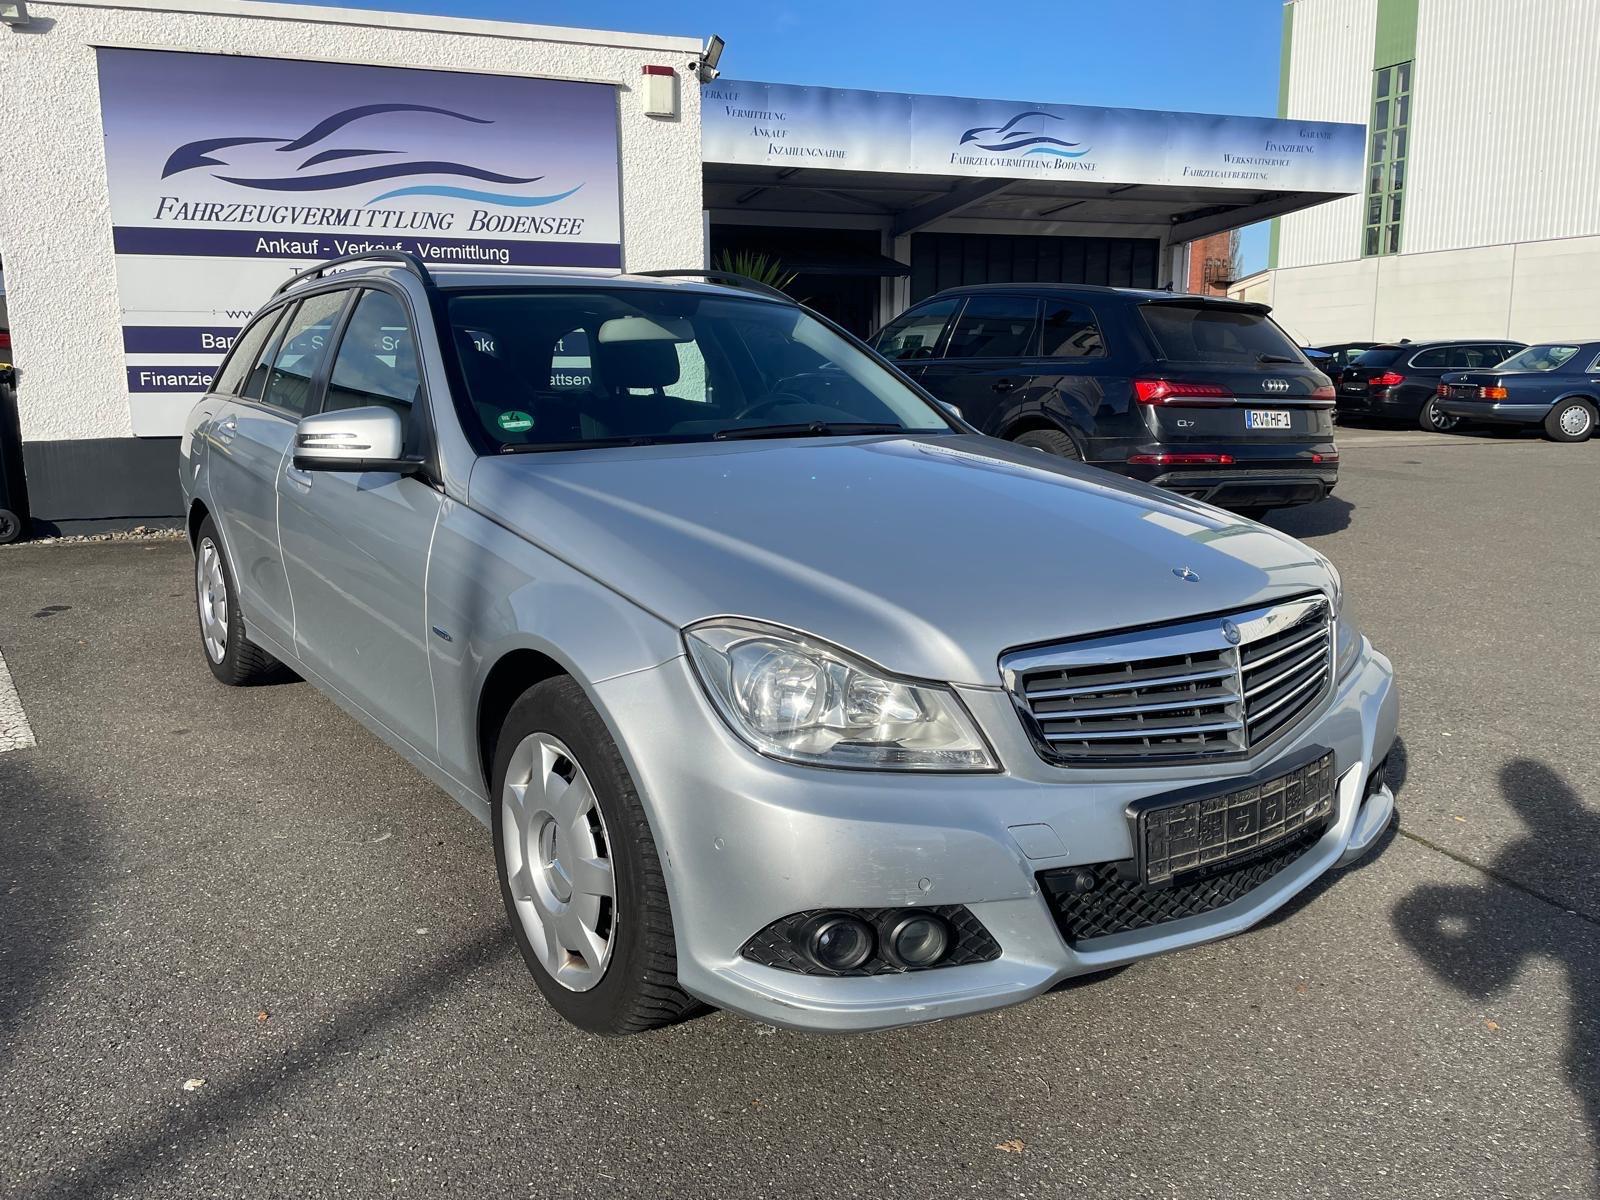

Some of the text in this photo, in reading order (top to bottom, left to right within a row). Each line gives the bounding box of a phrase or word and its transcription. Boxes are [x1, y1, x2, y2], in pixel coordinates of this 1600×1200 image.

[700, 89, 740, 101] ERKAUF
[725, 105, 786, 121] VERMITTLUNG
[751, 125, 788, 138] ANKAUF
[768, 143, 848, 159] INZAHLUNGNAHME
[1265, 140, 1315, 153] FINANZIERUNG
[950, 152, 1098, 171] FAHRZEUGVERMITTLUNG BODENSEE
[153, 196, 585, 236] FAHRZEUGVERMITTLUNG BODENSEE
[255, 237, 318, 254] Ankauf
[416, 242, 510, 264] Vermittlung
[1177, 419, 1195, 428] Q7
[1252, 412, 1265, 426] RV
